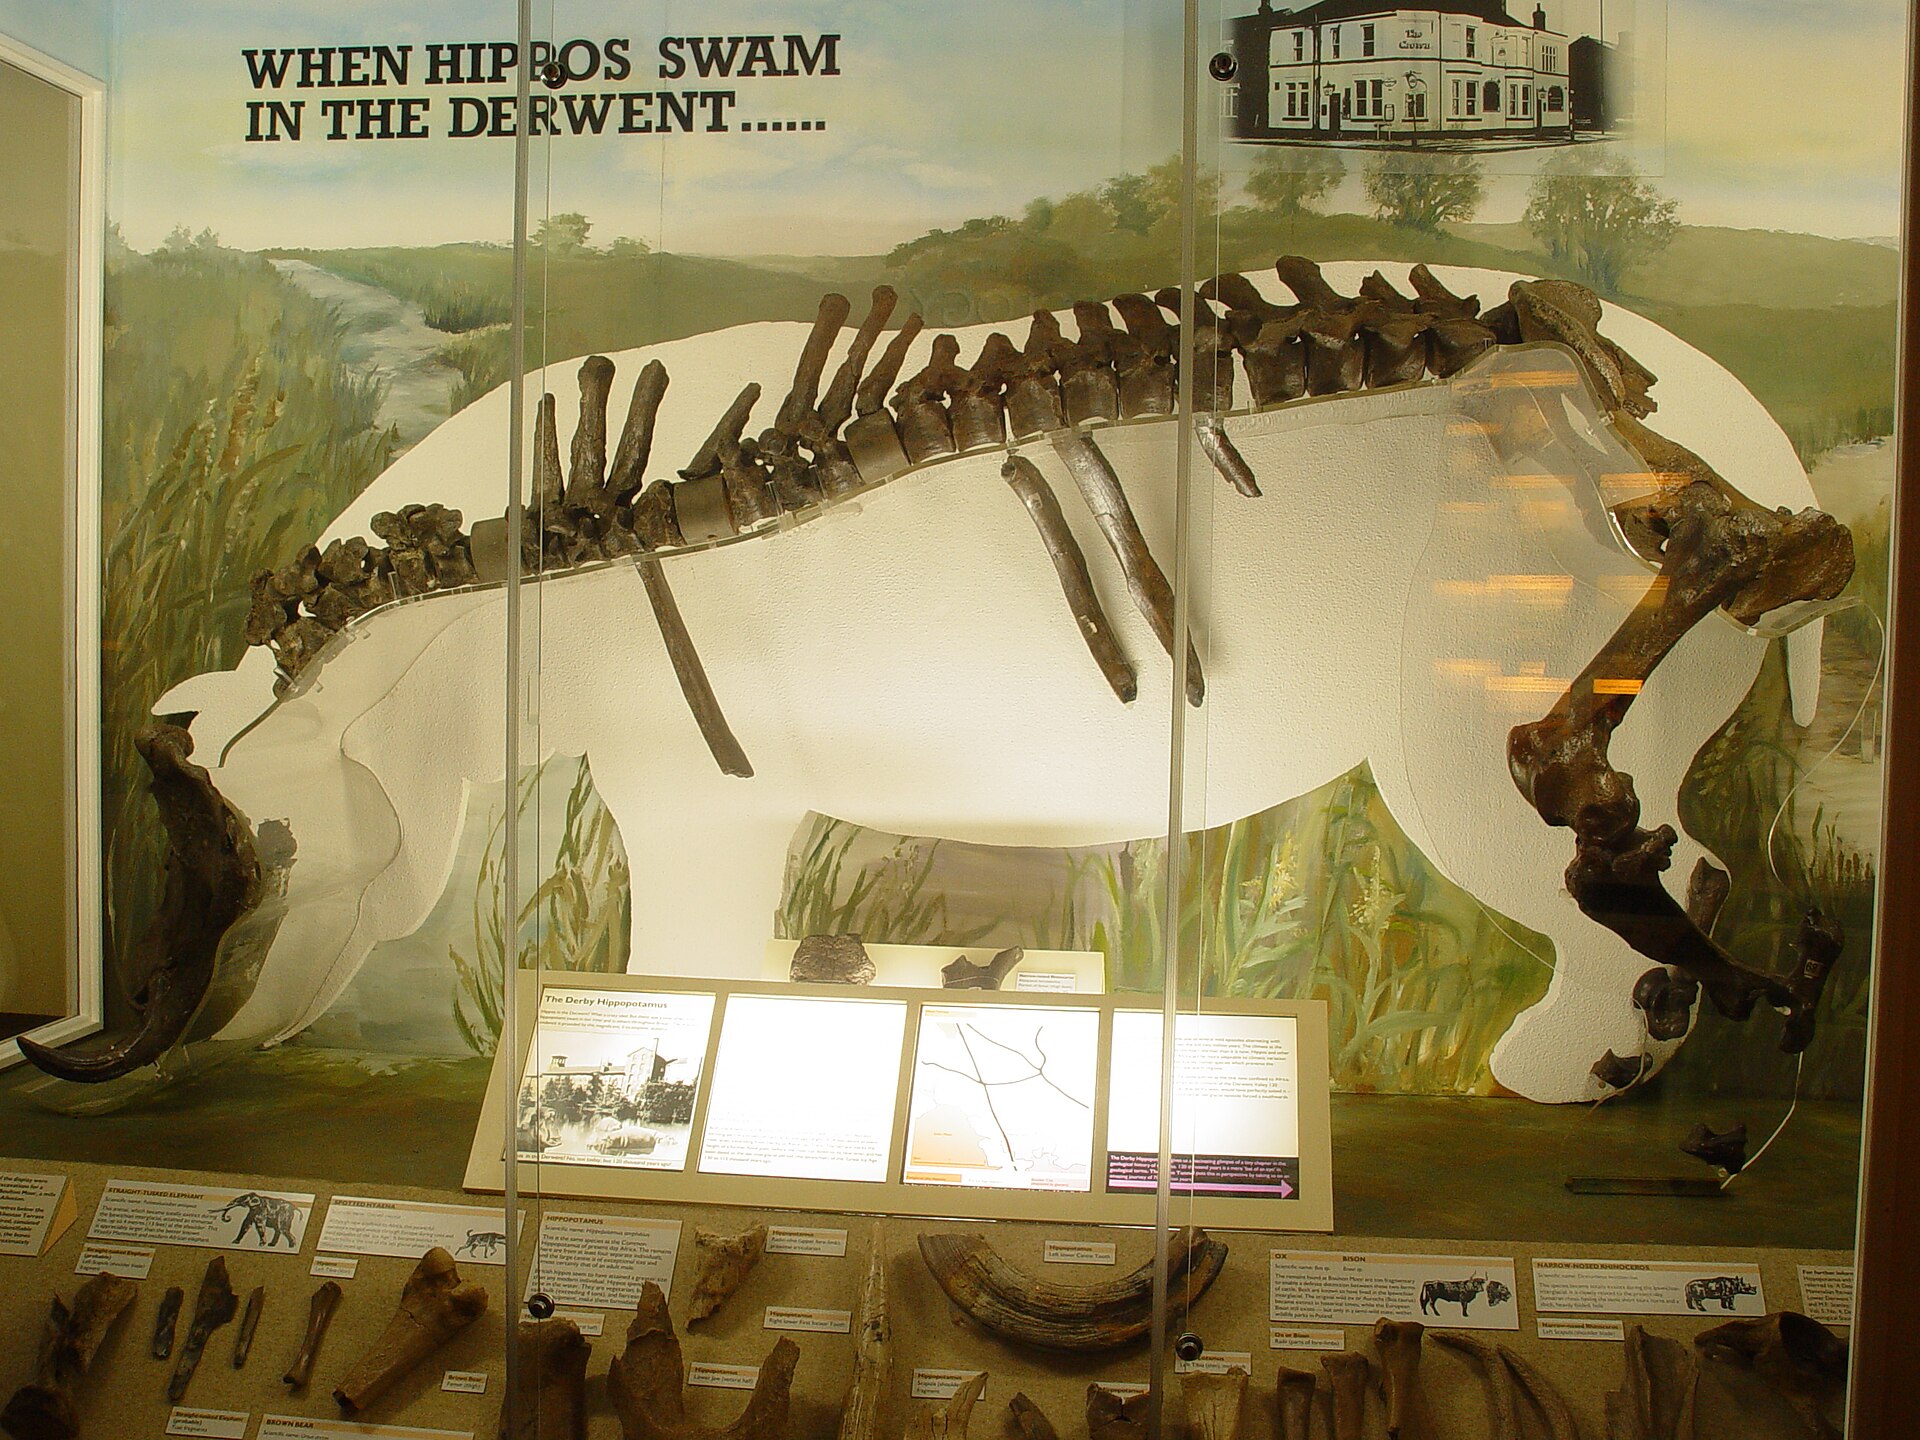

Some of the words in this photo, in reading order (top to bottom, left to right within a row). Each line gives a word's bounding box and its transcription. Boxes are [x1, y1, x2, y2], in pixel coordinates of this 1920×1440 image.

[242, 46, 413, 89] WHEN
[424, 39, 632, 84] HIPPOS
[659, 33, 842, 78] SWAM
[244, 101, 305, 142] IN
[321, 98, 430, 140] THE
[545, 995, 563, 1003] The
[565, 996, 595, 1006] Derby
[597, 998, 668, 1009] Hippopotamus
[108, 1187, 169, 1197] STRAIGHT-TUSKED
[169, 1191, 205, 1200] ELEPHANT
[366, 1201, 396, 1209] HYAENA
[546, 1215, 604, 1225] HIPPOPOTAMUS
[584, 1237, 604, 1245] species
[621, 1238, 647, 1246] Common
[588, 1244, 608, 1252] present
[559, 1254, 573, 1262] large
[556, 1260, 579, 1268] certainly
[1537, 1262, 1600, 1270] NARROW-NOSED
[1599, 1263, 1651, 1271] RHINOCEROS
[607, 1278, 626, 1287] Hippos
[266, 1419, 294, 1427] BROWN
[294, 1421, 314, 1429] BEAR
